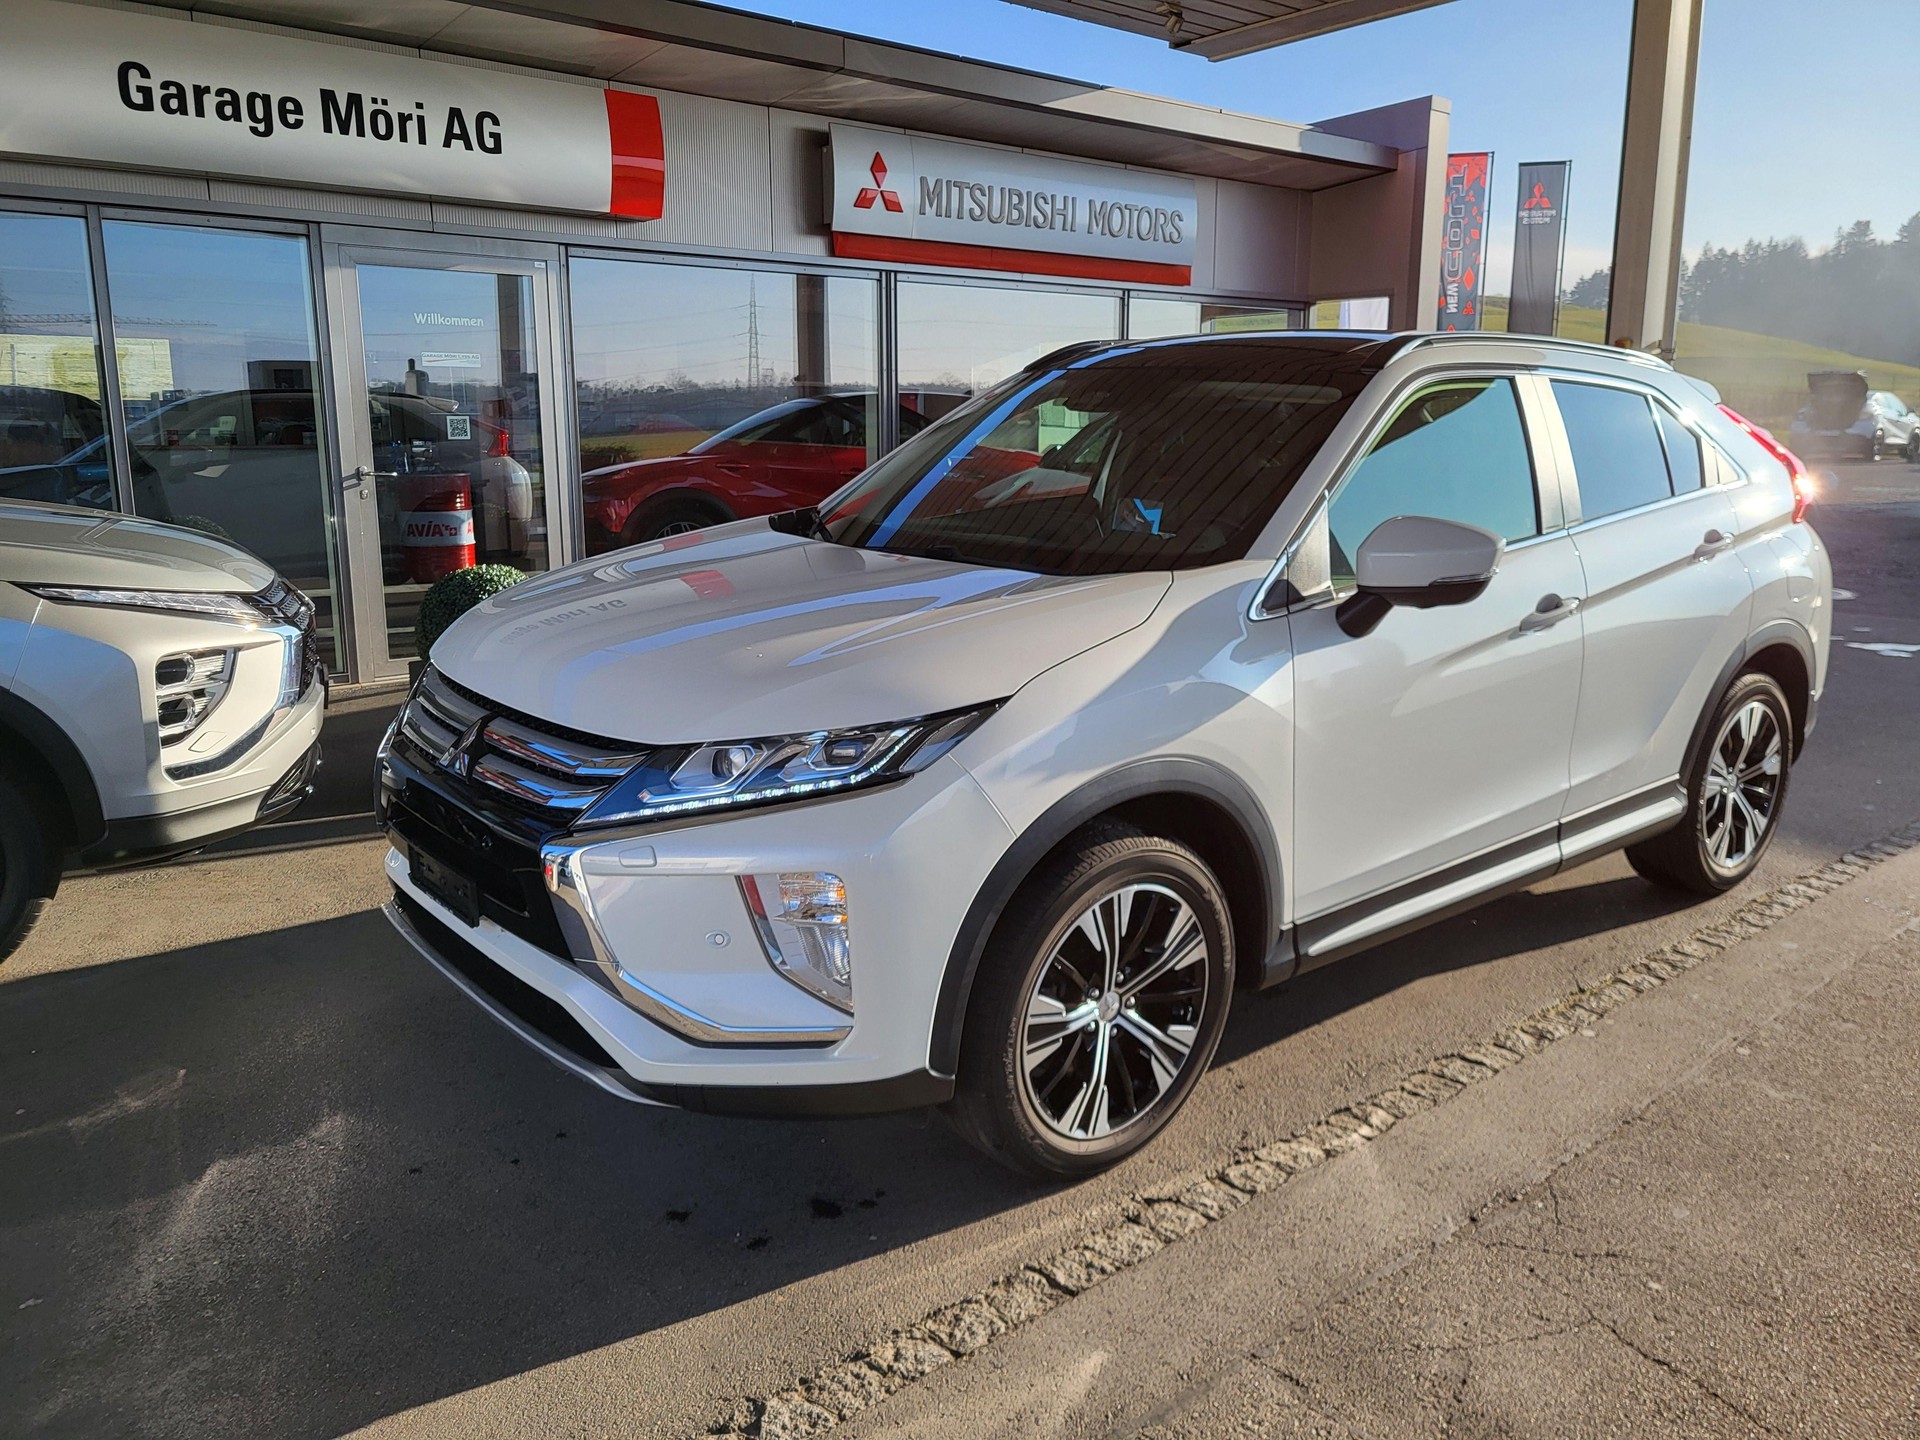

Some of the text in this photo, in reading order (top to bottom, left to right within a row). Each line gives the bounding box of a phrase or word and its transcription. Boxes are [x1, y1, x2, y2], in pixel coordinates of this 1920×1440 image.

[117, 60, 503, 155] Garage Möri AG
[919, 176, 1184, 244] MITSUBISHI MOTORS
[413, 312, 484, 327] Willkommen
